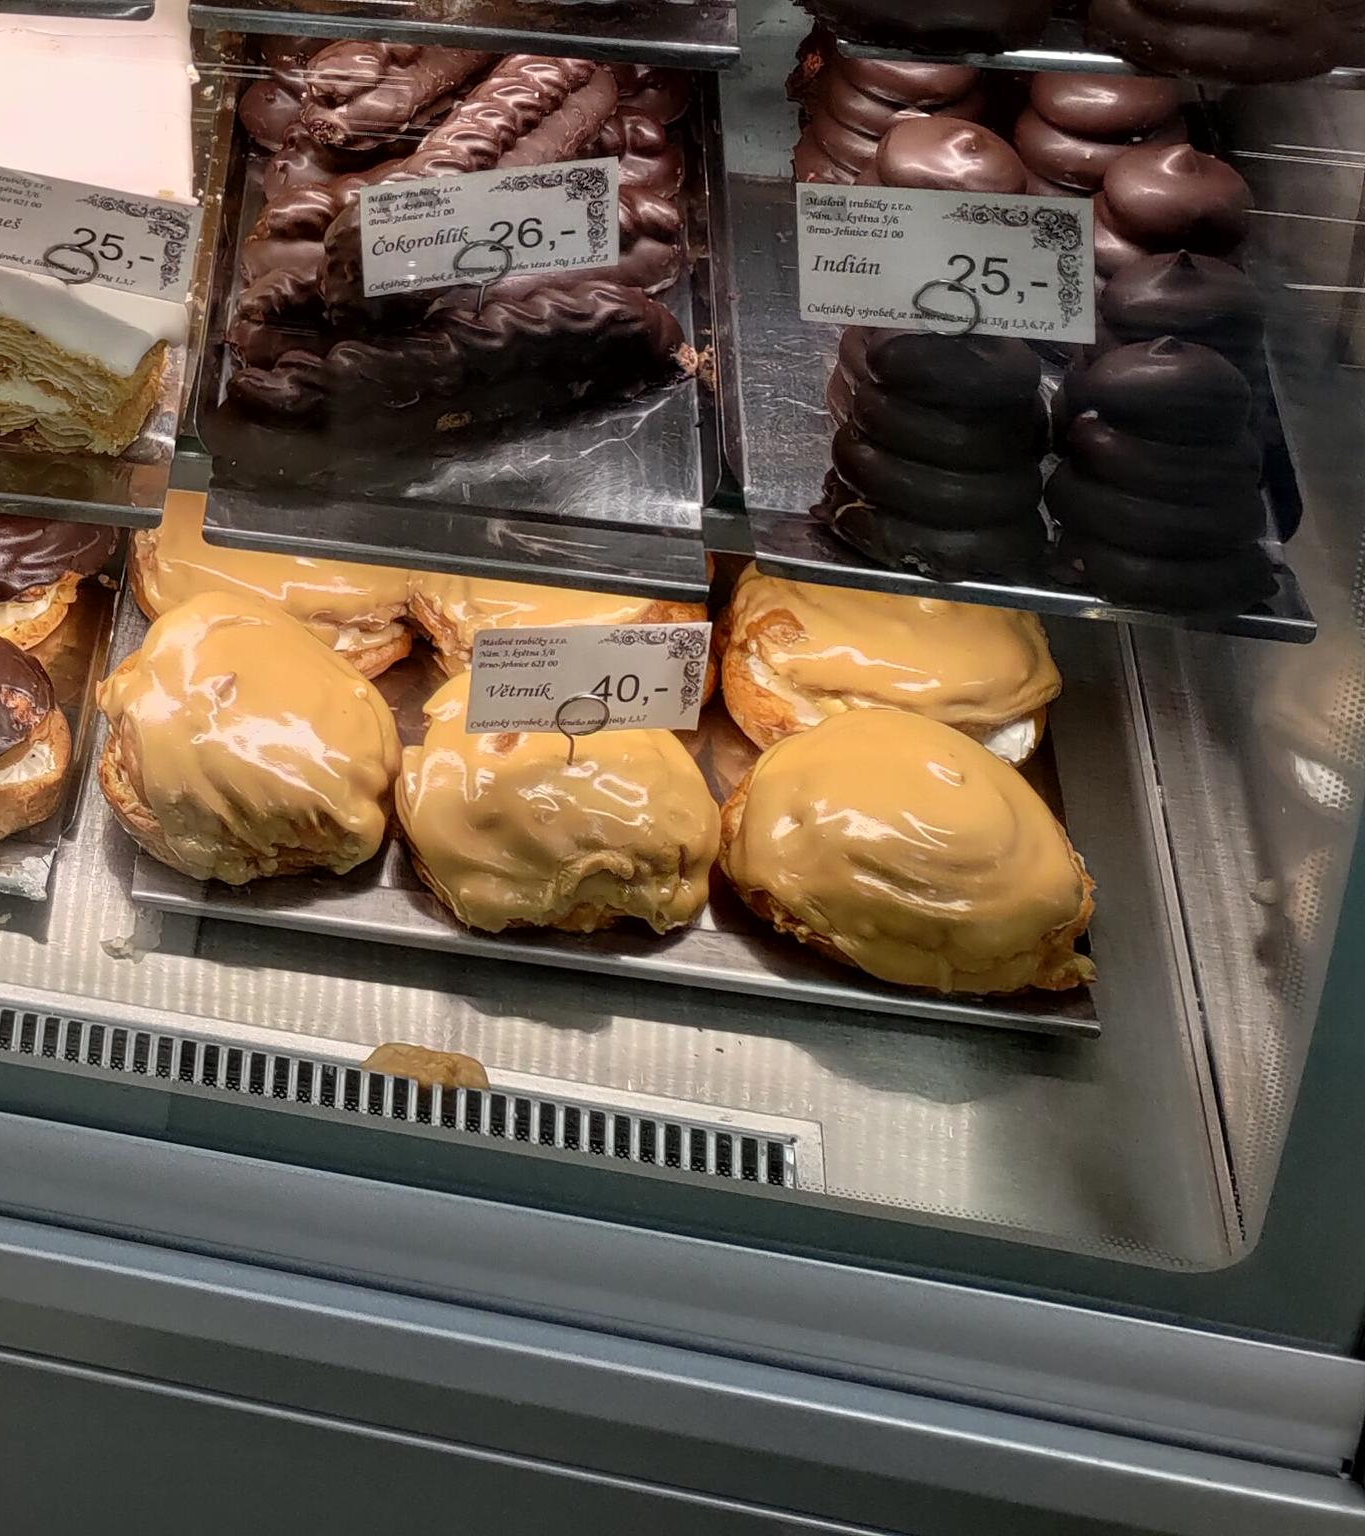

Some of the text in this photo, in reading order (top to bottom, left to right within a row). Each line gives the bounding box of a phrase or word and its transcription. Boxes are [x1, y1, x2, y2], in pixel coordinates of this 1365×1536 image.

[847, 212, 899, 226] května 5/6
[849, 198, 888, 212] trubičky
[73, 228, 154, 269] 25,-
[372, 218, 576, 257] Čokorohlík 26,-
[806, 225, 904, 240] Brno-Jehnice 621 00
[811, 254, 1048, 304] Indián 25,-
[486, 674, 668, 706] Větrník 40,-
